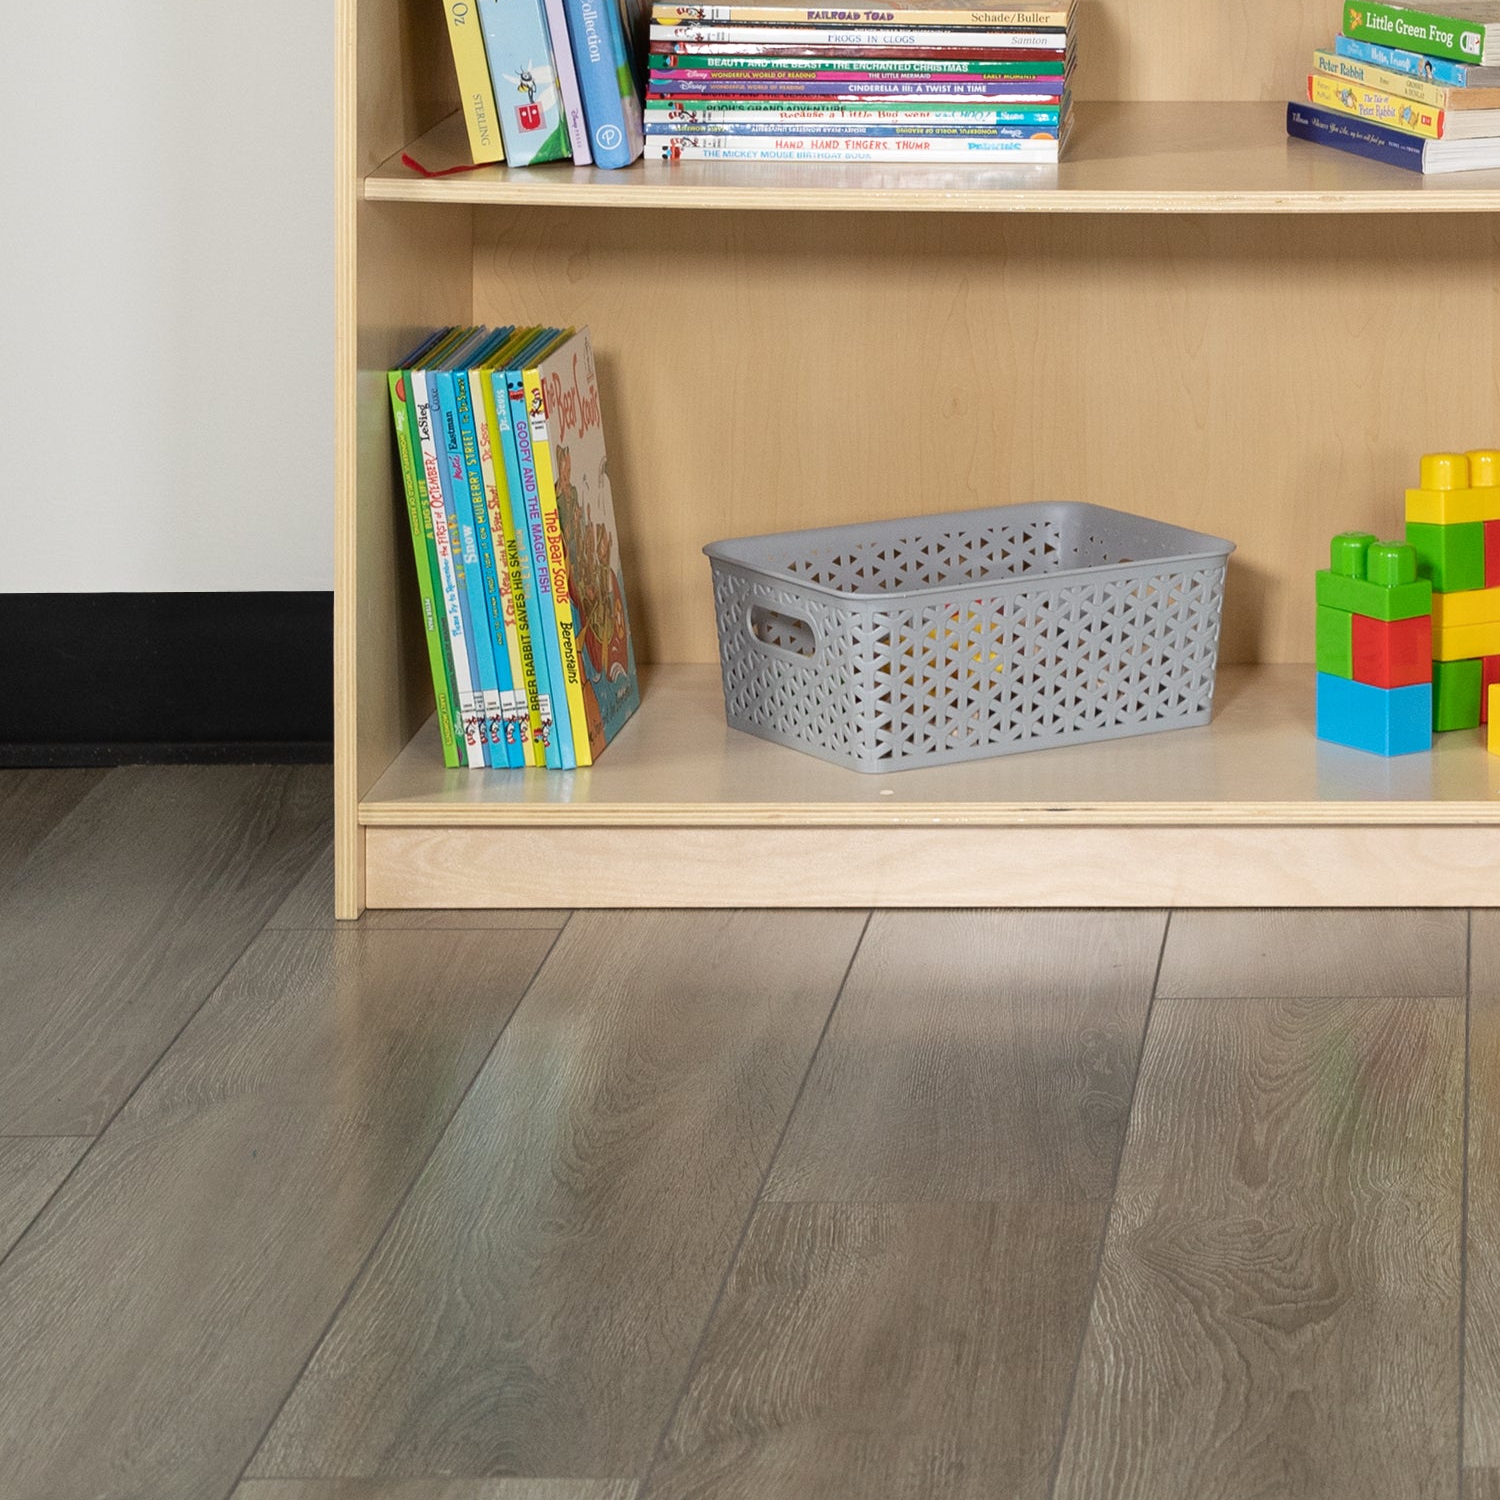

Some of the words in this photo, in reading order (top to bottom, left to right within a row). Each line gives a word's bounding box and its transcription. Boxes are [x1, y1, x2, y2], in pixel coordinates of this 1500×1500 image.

[452, 2, 469, 26] Oz
[806, 10, 861, 21] RAILROAD
[863, 11, 895, 21] TOAD
[971, 12, 1051, 24] Schade/Buller
[867, 35, 878, 43] IN
[883, 35, 916, 44] CLOGS
[1011, 36, 1048, 46] Samton
[1365, 12, 1394, 32] Little
[1395, 18, 1427, 39] Green
[1429, 25, 1455, 48] Frog
[853, 62, 912, 72] ENCHANTED
[913, 63, 969, 73] CHRISTMAS
[1318, 57, 1339, 74] Peter
[1340, 63, 1365, 82] Rabbit
[680, 80, 707, 92] Disney
[848, 84, 899, 92] CINDERELLA
[916, 84, 923, 92] A
[926, 85, 951, 93] TWIST
[954, 85, 964, 93] IN
[967, 85, 987, 93] TIME
[472, 94, 491, 146] STERLING
[1359, 104, 1375, 117] Peter
[703, 149, 722, 157] THE
[724, 150, 758, 158] MICKEY
[760, 150, 794, 159] MOUSE
[775, 139, 803, 149] HAND
[811, 140, 839, 150] HAND
[431, 389, 440, 412] Coxe
[496, 389, 506, 416] Seuss
[417, 403, 430, 441] LeSieg
[446, 411, 458, 450] Eastman
[499, 418, 510, 431] Dr.
[462, 430, 477, 466] STREET
[516, 421, 532, 463] GOOFY
[418, 480, 426, 496] LIFE
[424, 451, 444, 509] OCTEMBER!
[522, 466, 536, 493] AND
[469, 471, 485, 525] MULBERRY
[527, 496, 541, 519] THE
[426, 531, 434, 539] A
[435, 520, 448, 546] FIRST
[544, 509, 558, 534] The
[463, 524, 478, 564] Snow
[507, 539, 521, 567] SKIN
[531, 523, 546, 563] MAGIC
[547, 534, 562, 566] Bear
[512, 570, 523, 591] HIS
[538, 566, 551, 594] FISH
[552, 567, 569, 604] Scouts
[516, 593, 529, 631] SAVES
[520, 634, 535, 678] RABBIT
[560, 621, 578, 685] Berenstains
[527, 679, 540, 711] BRER
